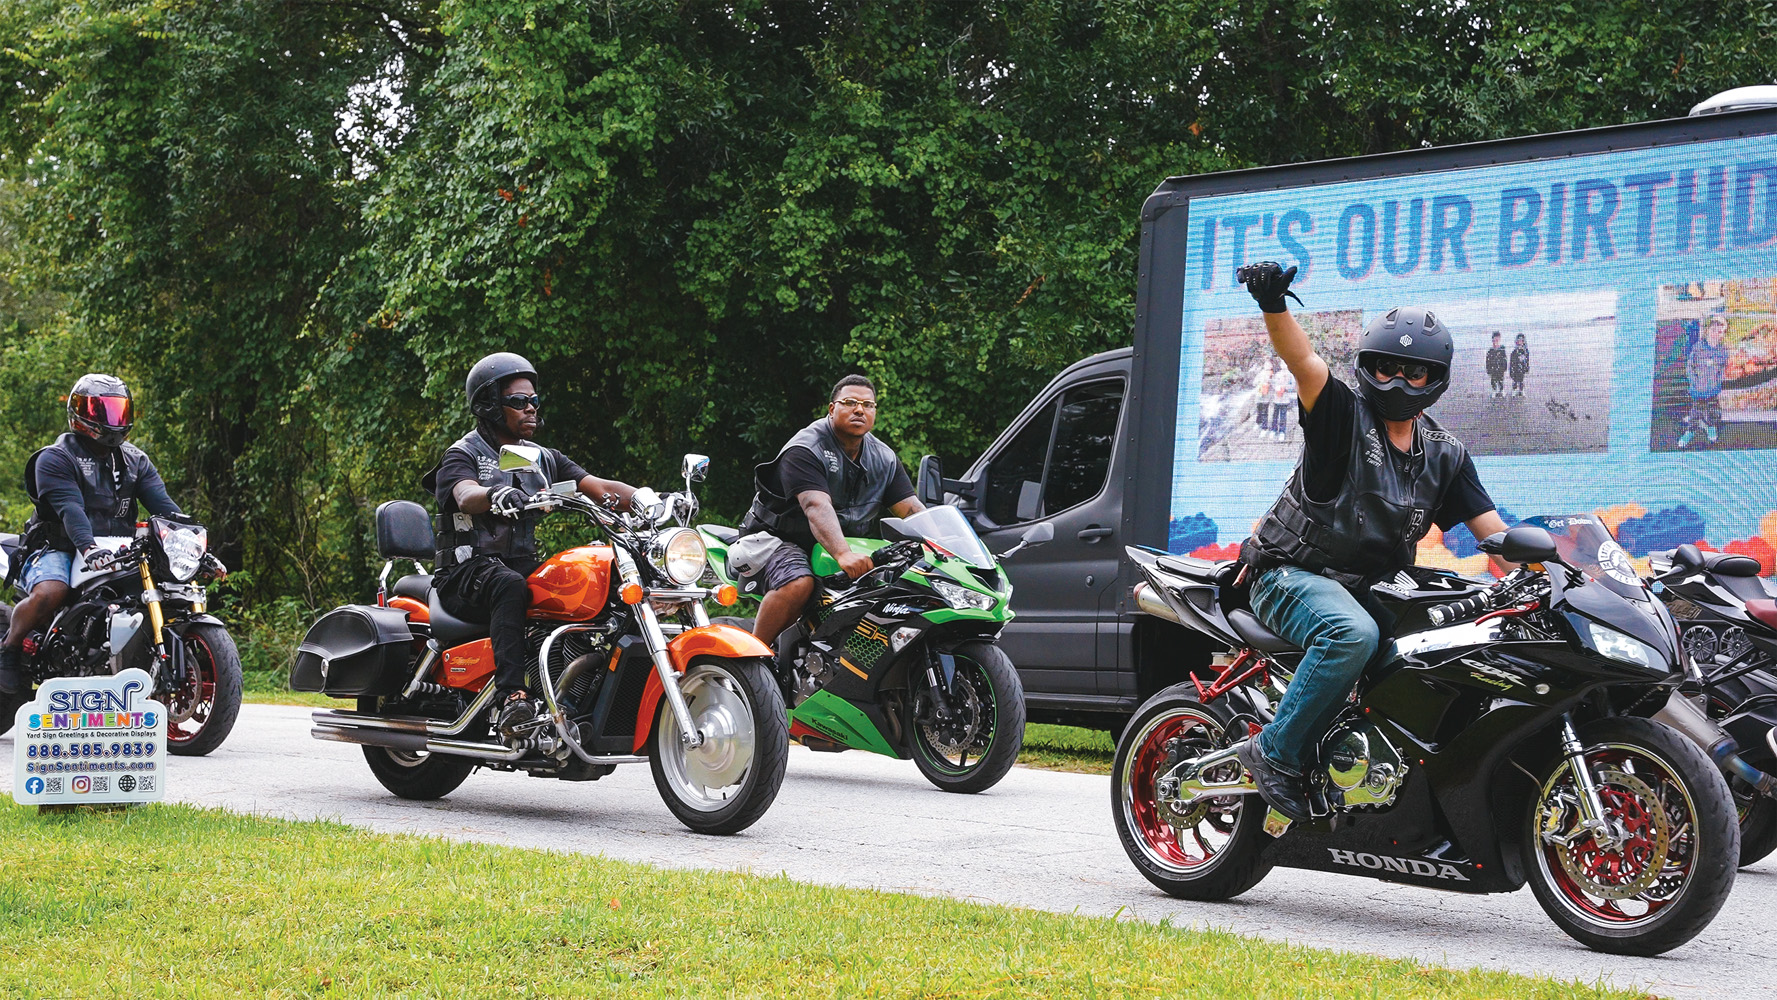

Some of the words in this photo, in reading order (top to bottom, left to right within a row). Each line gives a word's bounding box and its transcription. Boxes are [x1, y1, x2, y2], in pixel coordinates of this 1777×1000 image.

[1201, 208, 1314, 293] IT'S
[1336, 194, 1475, 282] OUR
[1499, 161, 1777, 270] BIRTHD
[1377, 580, 1411, 597] HONDA
[881, 602, 911, 616] Ninja
[49, 682, 141, 712] SIGN
[29, 712, 157, 729] SENTIMENTS
[811, 717, 849, 741] Kawasaki
[42, 732, 57, 740] Sign
[59, 731, 89, 739] Greetings
[131, 730, 157, 738] Displays
[27, 742, 157, 758] 888.585.9839
[26, 761, 157, 774] SignSentiments.com
[1327, 847, 1471, 882] HONDA
